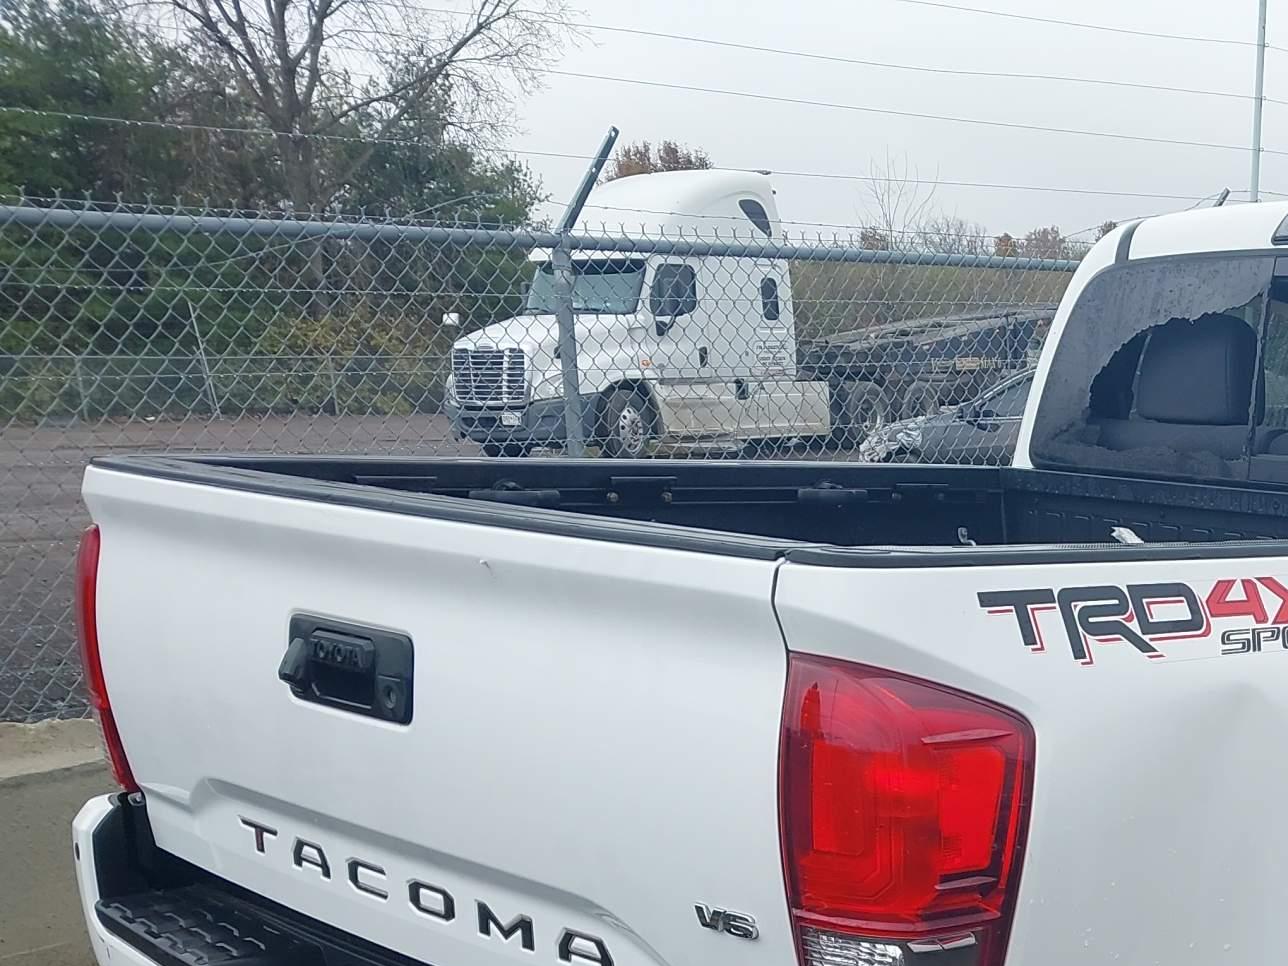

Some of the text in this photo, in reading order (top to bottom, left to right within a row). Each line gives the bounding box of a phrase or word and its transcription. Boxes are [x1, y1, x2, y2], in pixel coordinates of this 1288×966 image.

[977, 582, 1211, 665] TRD
[309, 637, 367, 668] TOYOTA
[694, 902, 760, 940] V6
